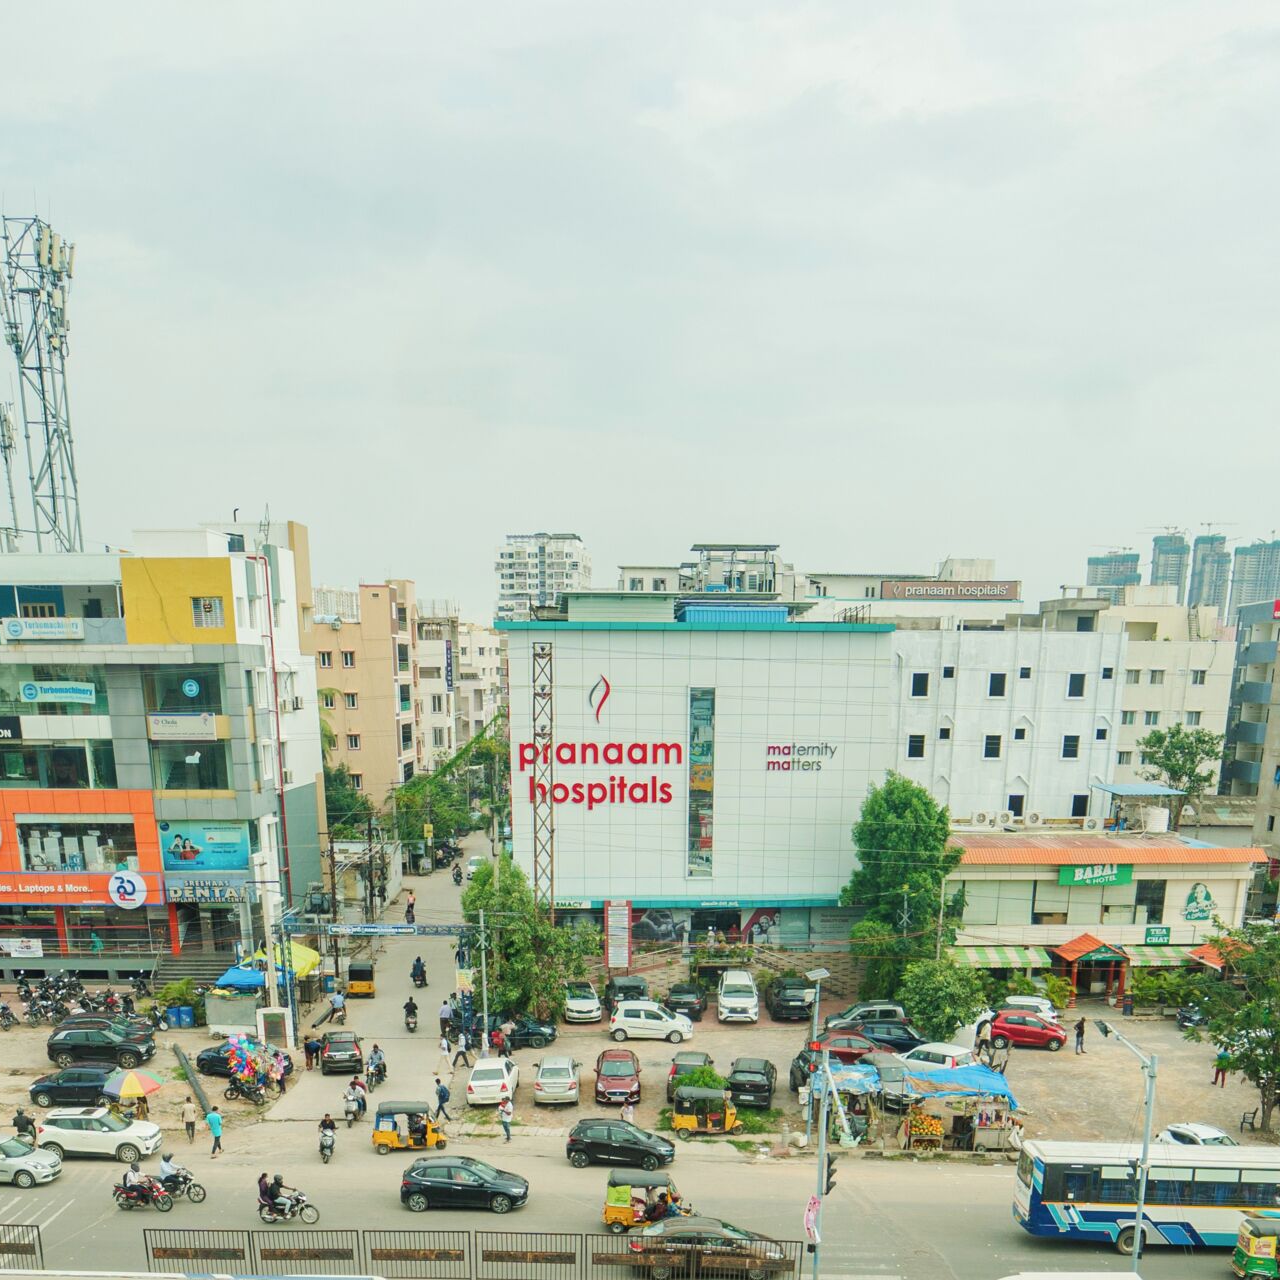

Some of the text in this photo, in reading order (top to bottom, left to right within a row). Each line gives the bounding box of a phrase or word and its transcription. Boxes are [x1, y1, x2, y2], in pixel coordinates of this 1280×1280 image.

[905, 585, 1006, 597] pranaam hospitals
[519, 742, 683, 770] pranaam
[767, 742, 837, 758] maternity
[766, 758, 822, 771] matters
[530, 776, 672, 810] hospitals
[1074, 864, 1118, 882] BABAI
[1092, 876, 1117, 884] HOTEL
[18, 884, 55, 894] Laptops
